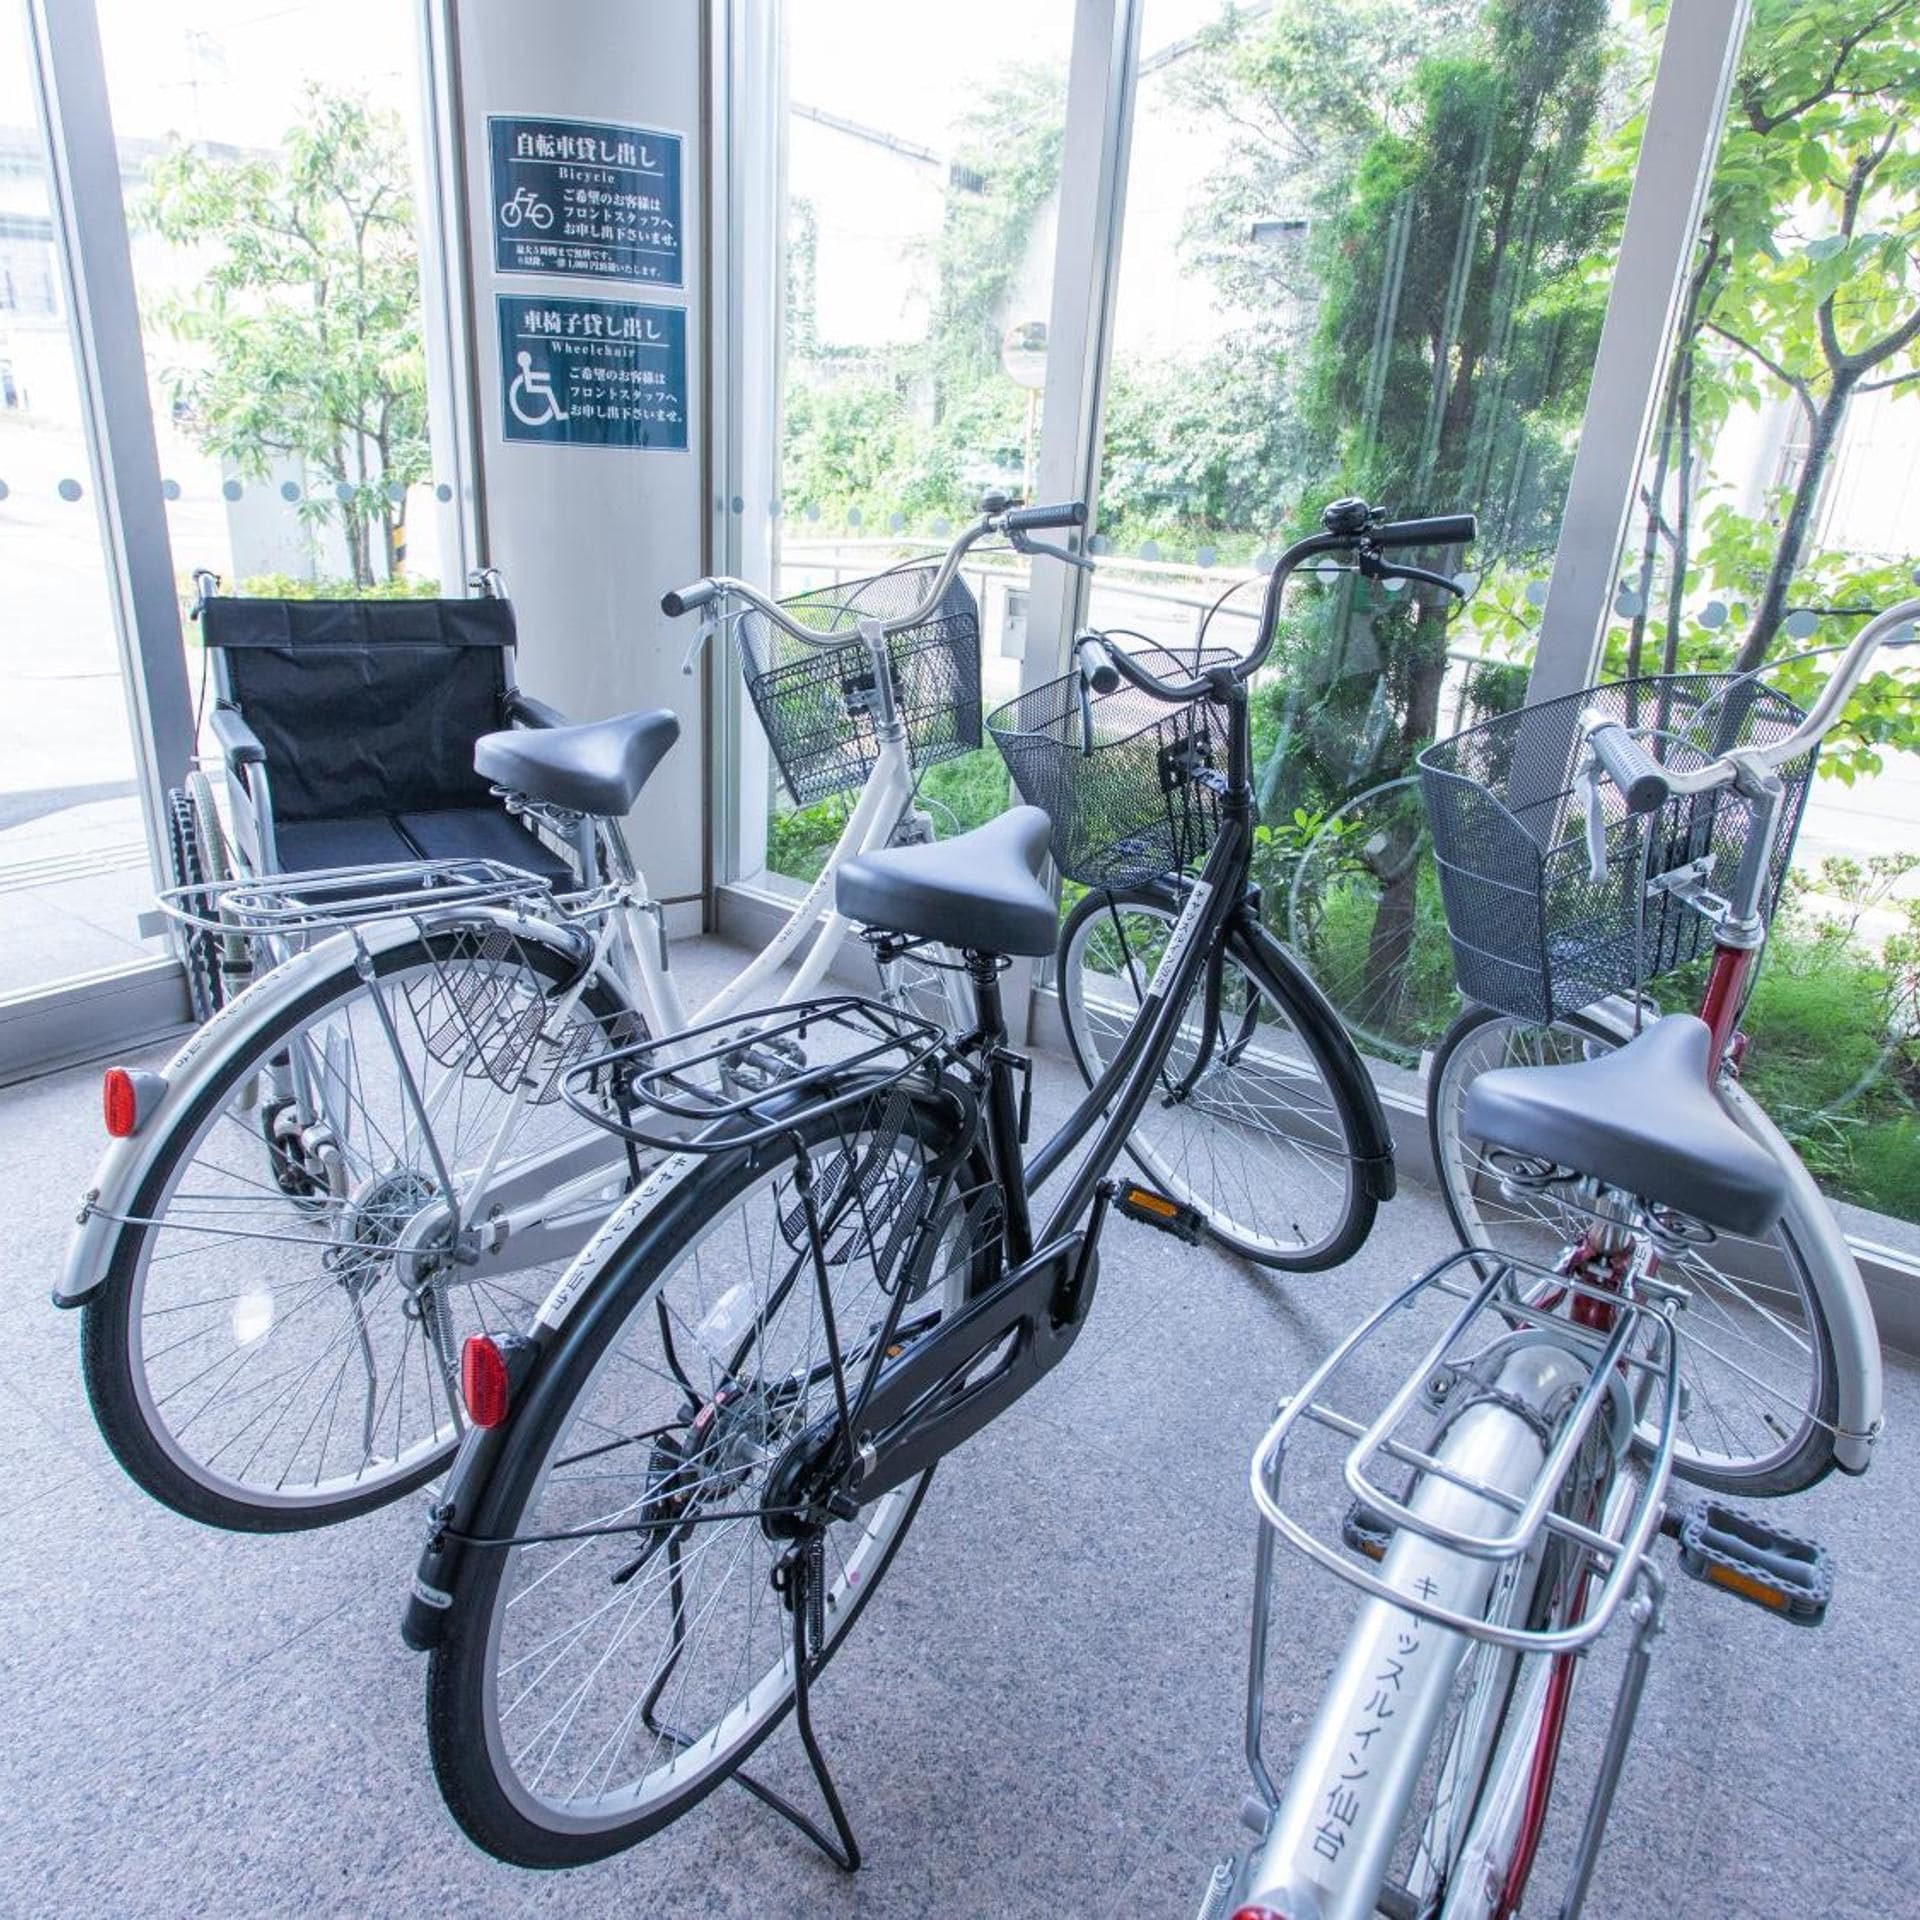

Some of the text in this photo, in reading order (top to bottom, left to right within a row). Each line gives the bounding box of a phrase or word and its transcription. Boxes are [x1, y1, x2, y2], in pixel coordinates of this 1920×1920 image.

[516, 132, 657, 168] 自転車貸し出し
[558, 167, 616, 184] Bicycle
[563, 188, 662, 211] ご希望のお客様は
[563, 206, 673, 229] フロントスタッフへ
[524, 309, 662, 340] 車椅子貸し出し
[551, 340, 636, 358] Wheelchair
[569, 366, 667, 385] ご希望のお客様は
[570, 386, 678, 403] フロントスタッフへ
[550, 1157, 687, 1311] キャッスルイン仙台
[1313, 1575, 1440, 1862] キッスルイン仙台
